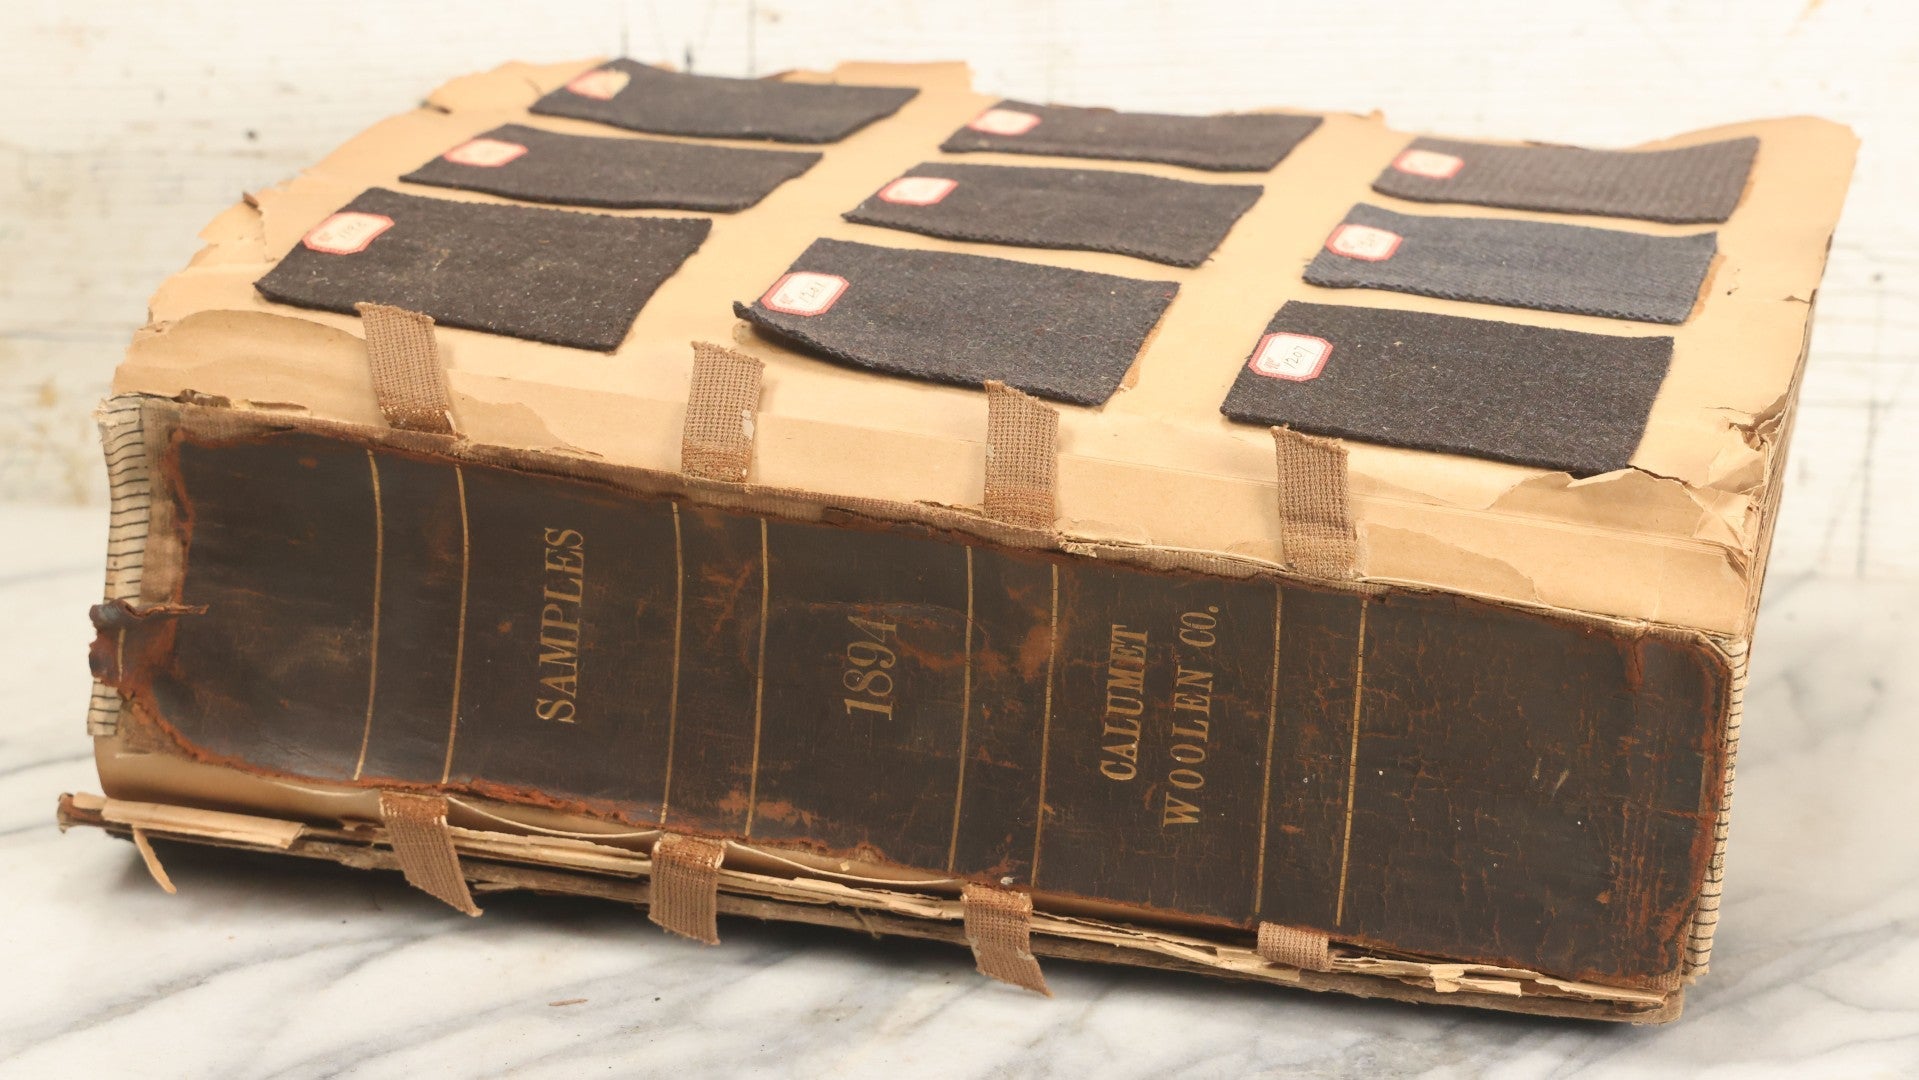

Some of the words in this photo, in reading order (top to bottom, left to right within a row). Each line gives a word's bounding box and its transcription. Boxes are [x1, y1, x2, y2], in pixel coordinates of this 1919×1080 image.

[1283, 345, 1315, 369] 1207
[535, 527, 584, 723] SAMPLES
[843, 615, 897, 720] 1894
[1179, 605, 1219, 648] CO.
[1100, 623, 1148, 781] CALUMET
[1163, 665, 1214, 827] WOOLEN
